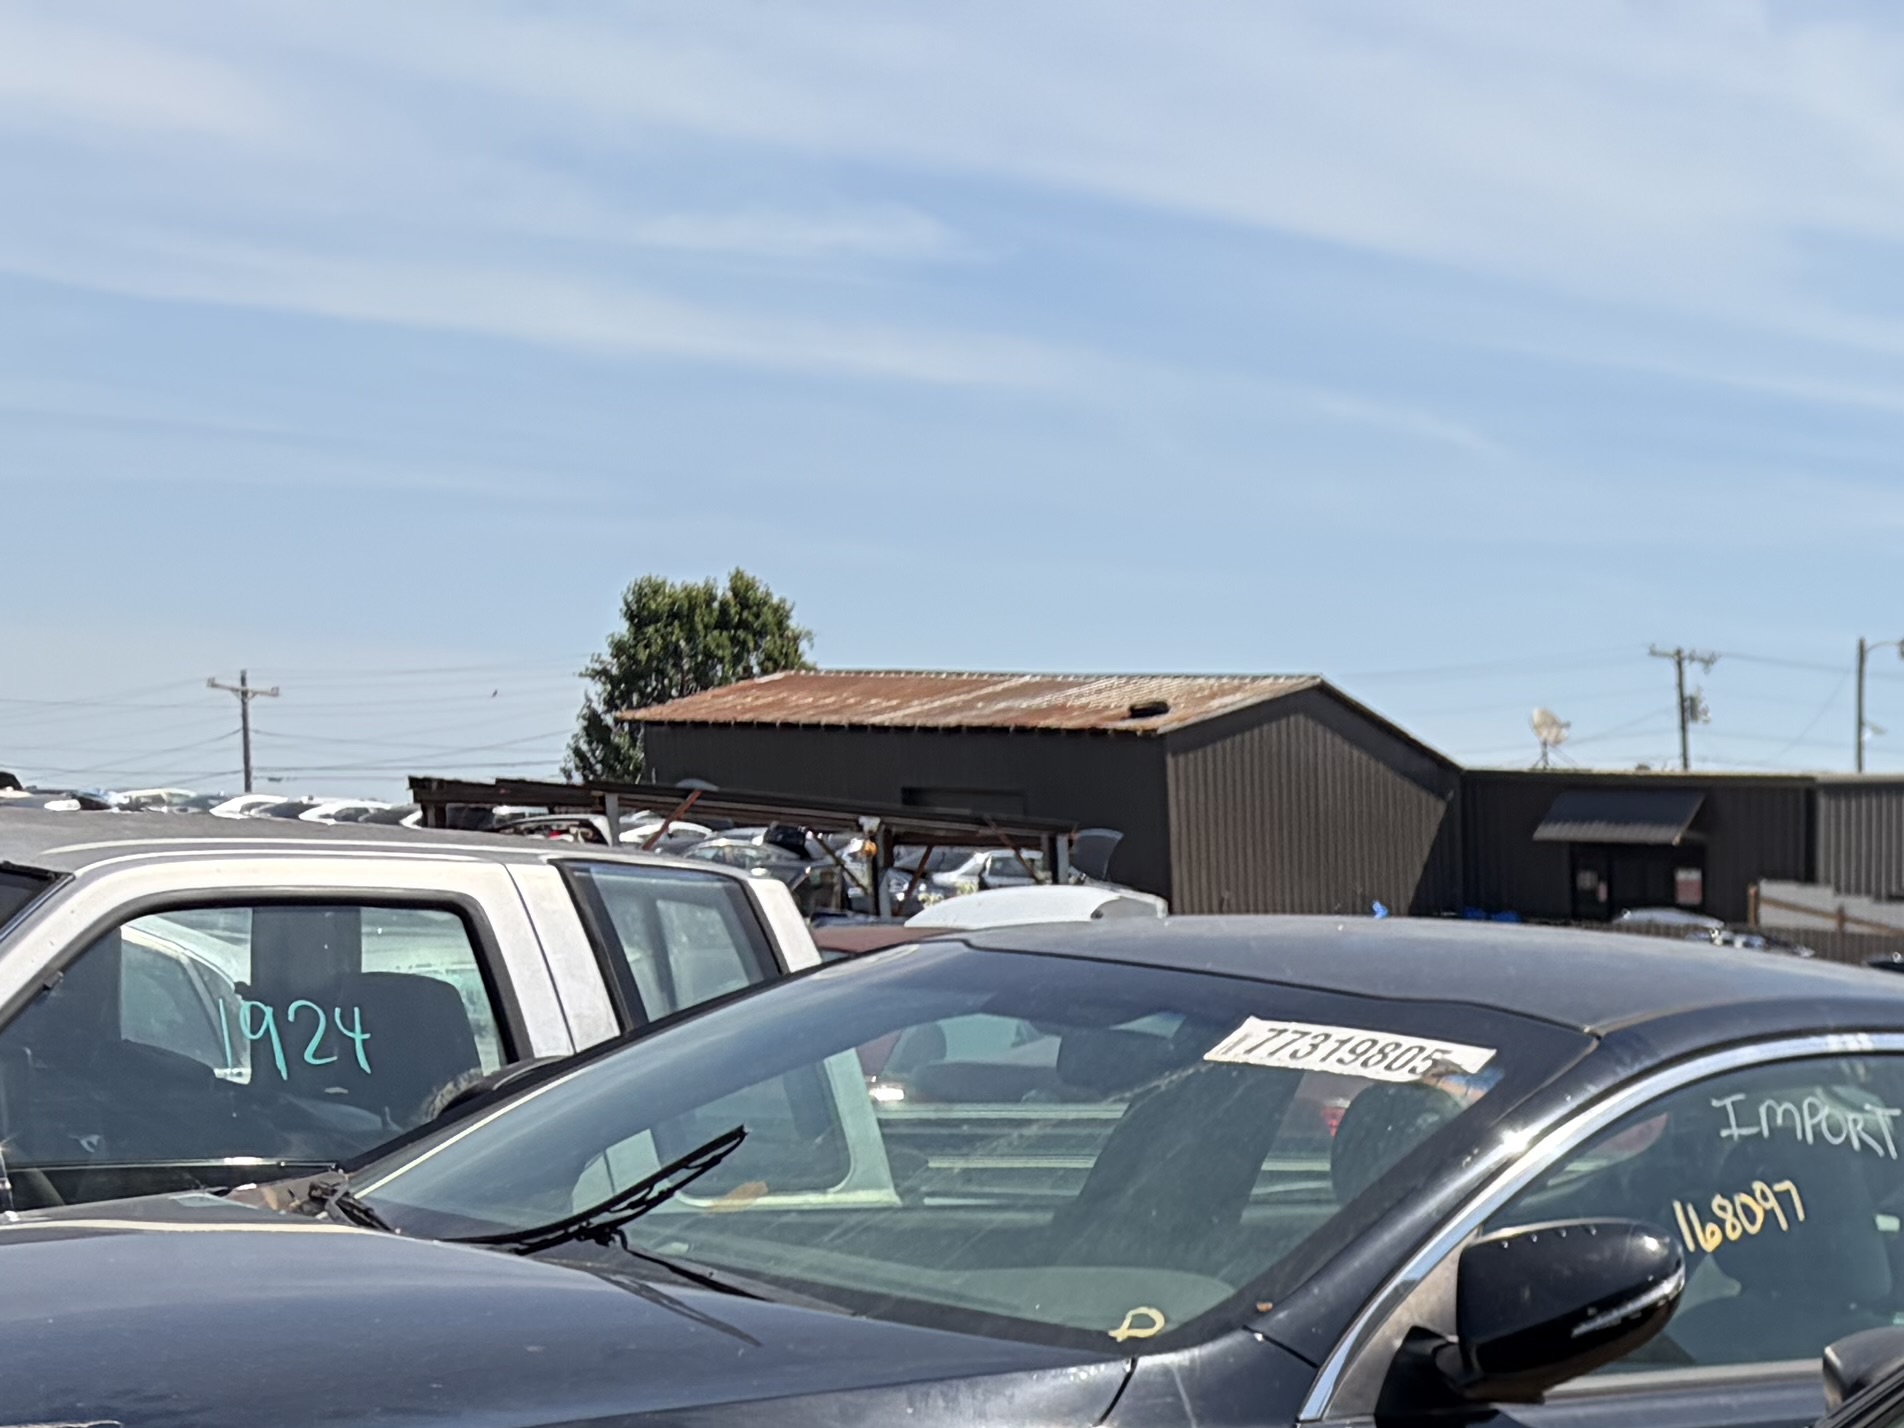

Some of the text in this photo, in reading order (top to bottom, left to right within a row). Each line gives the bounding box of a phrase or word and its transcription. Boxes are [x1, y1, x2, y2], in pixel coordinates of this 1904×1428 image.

[217, 997, 372, 1081] 1924
[1709, 1092, 1903, 1160] IMPORT
[1672, 1180, 1806, 1253] 168097
